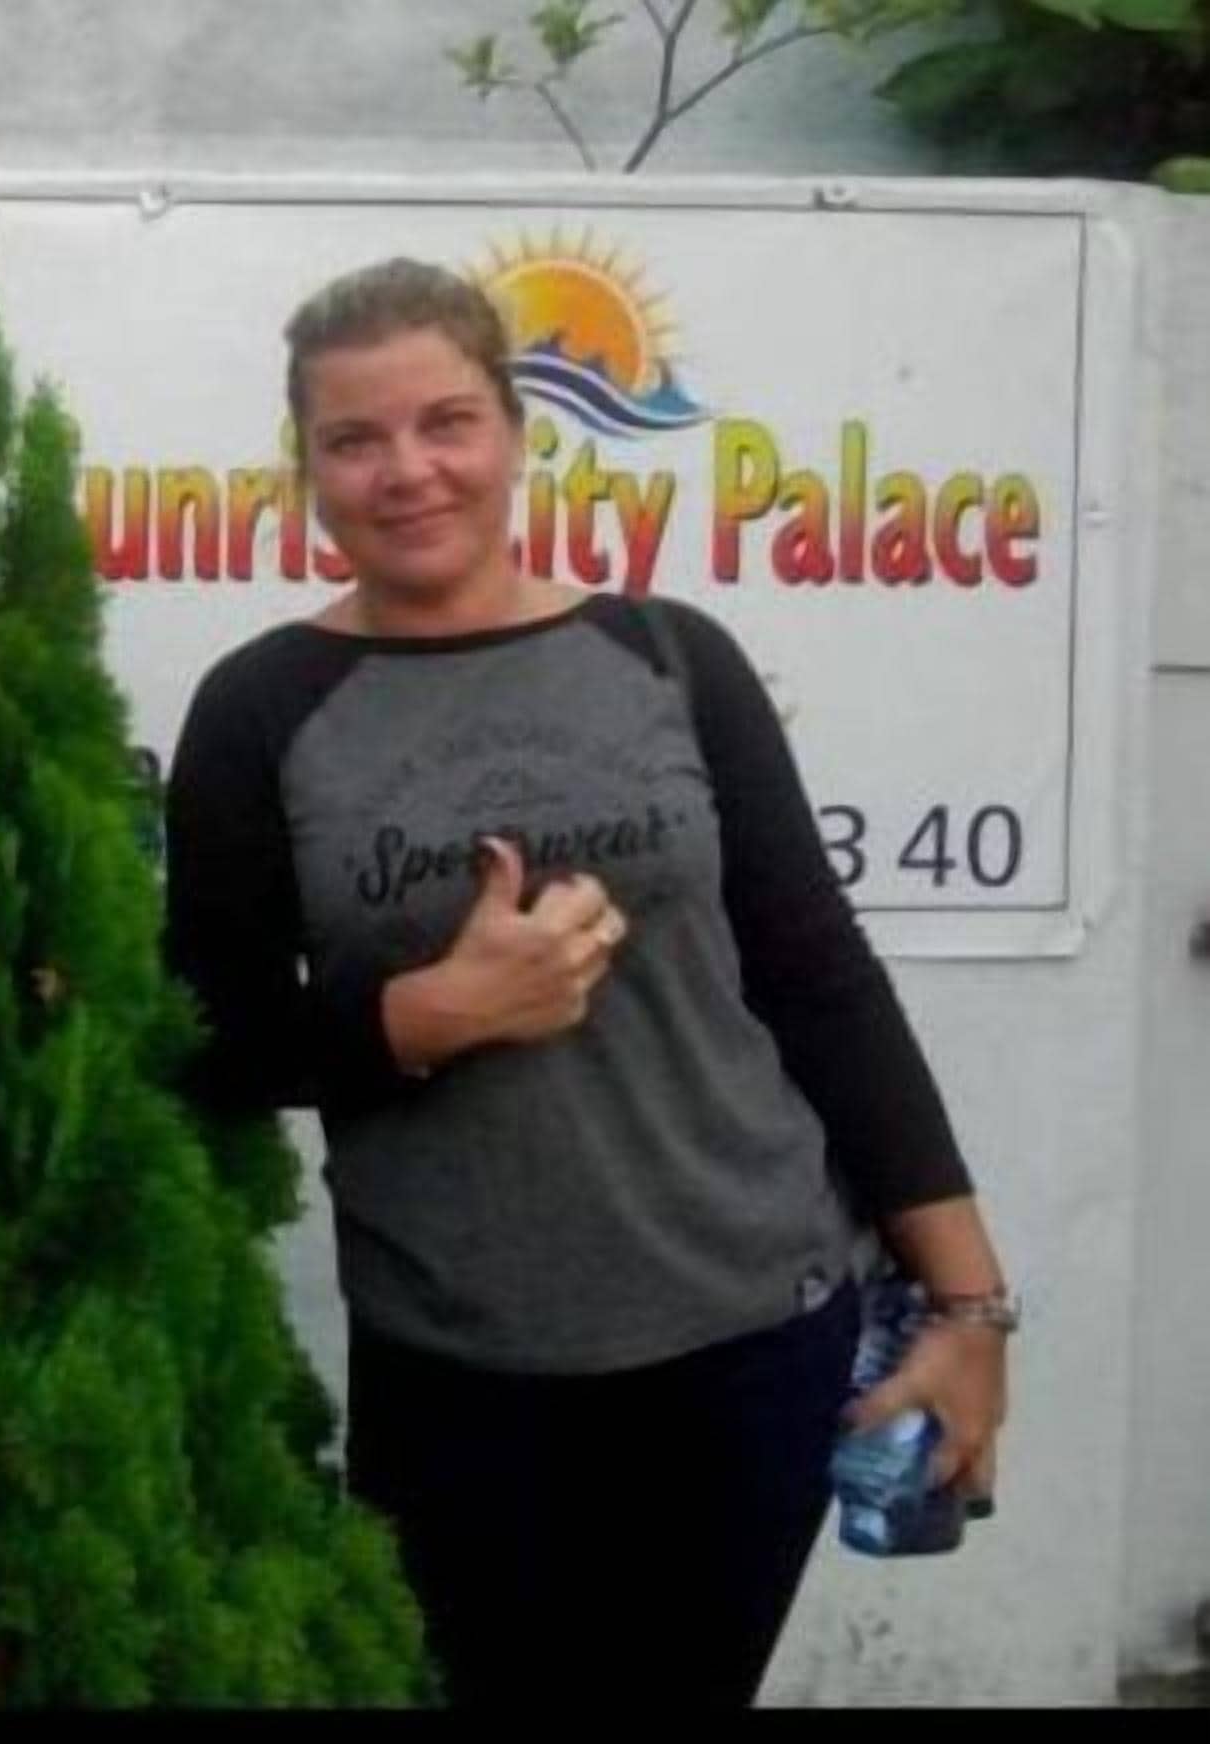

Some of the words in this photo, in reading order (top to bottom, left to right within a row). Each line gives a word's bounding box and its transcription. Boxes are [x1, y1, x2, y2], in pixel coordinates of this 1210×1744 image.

[512, 416, 677, 602] ity
[710, 418, 1040, 586] Palace
[897, 804, 1022, 888] 40
